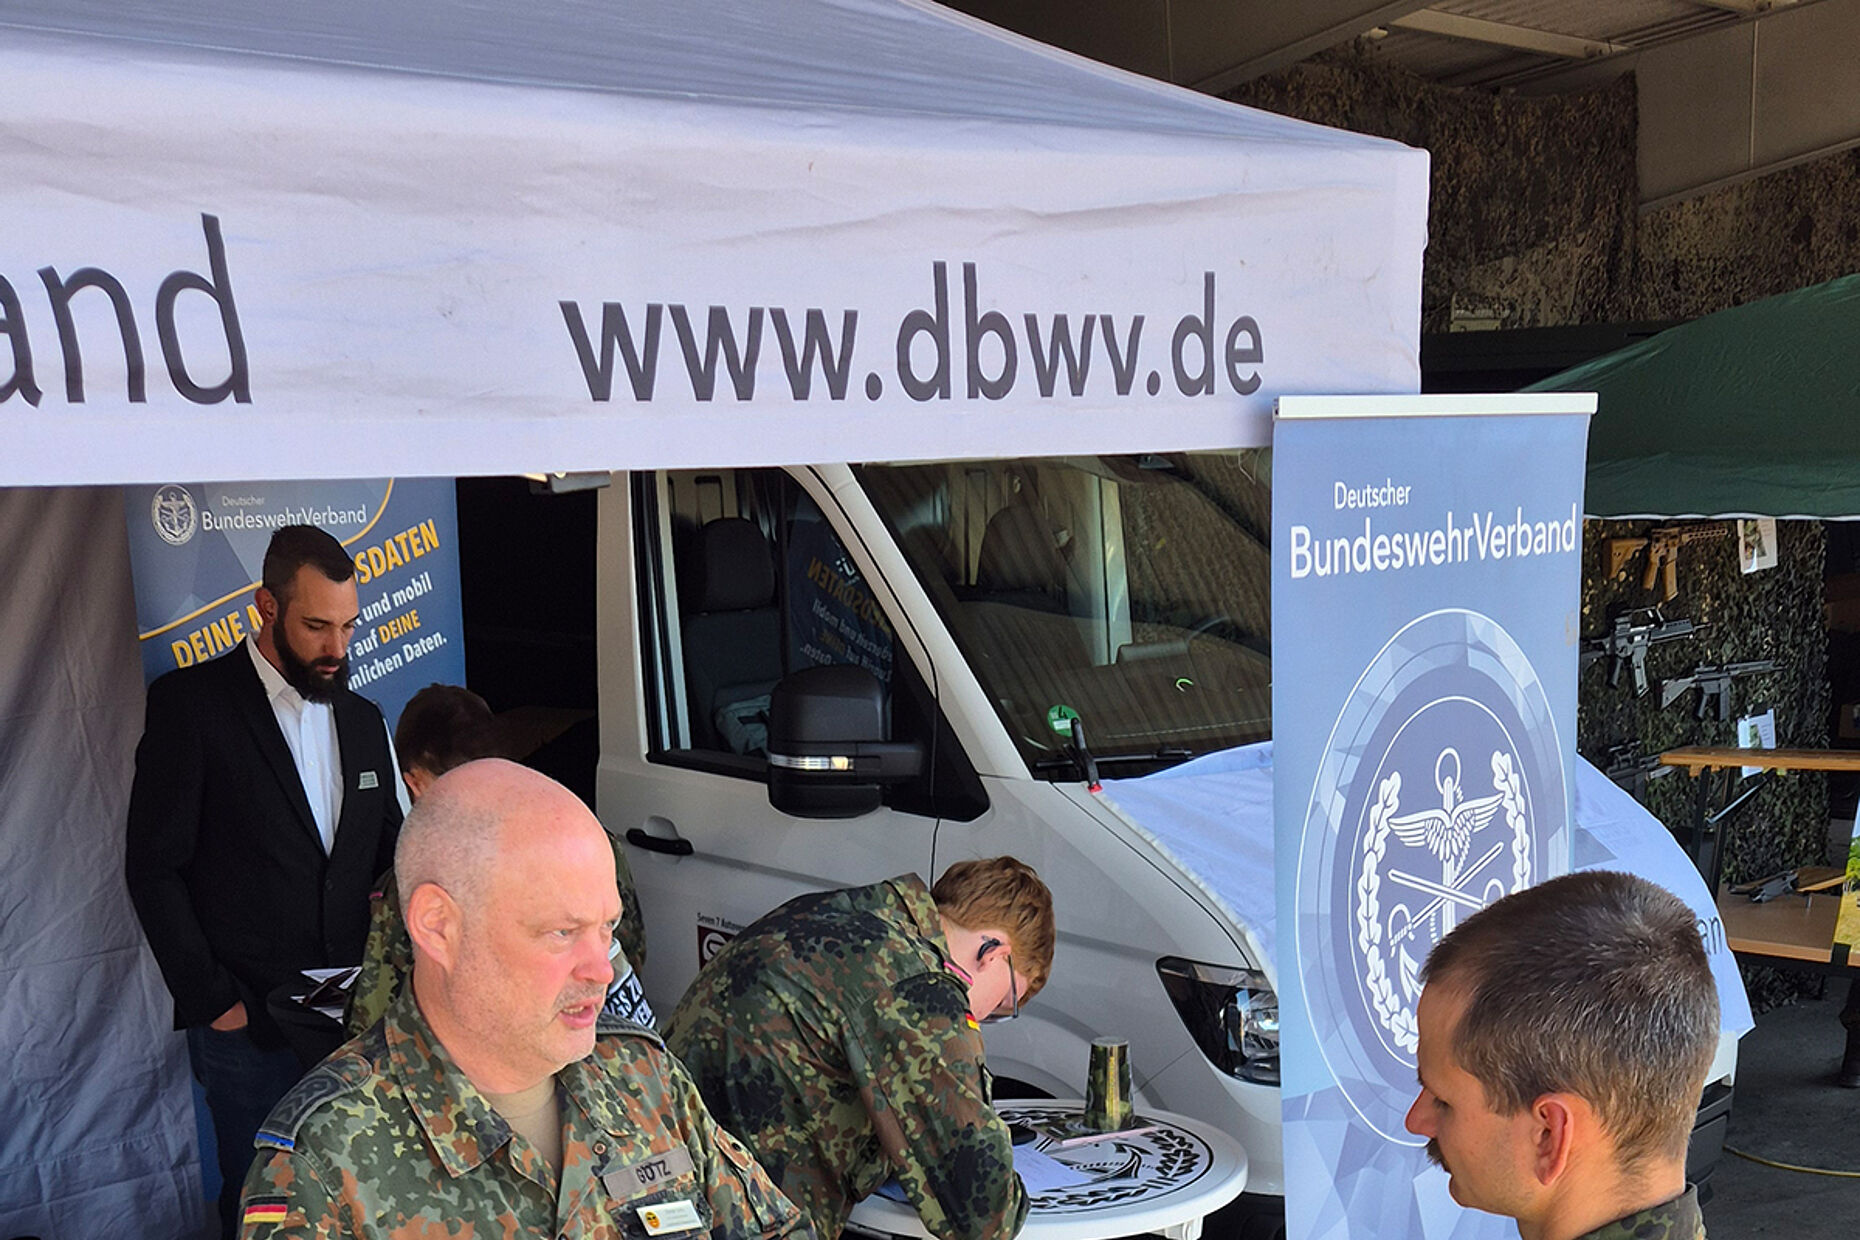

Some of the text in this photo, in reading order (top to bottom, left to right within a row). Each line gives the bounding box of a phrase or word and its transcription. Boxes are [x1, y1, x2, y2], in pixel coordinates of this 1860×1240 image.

[0, 212, 252, 408] and
[558, 260, 1264, 402] www.dbwv.de
[201, 504, 367, 531] BundeswehrVerband
[221, 495, 266, 507] Deutscher
[1334, 477, 1412, 510] Deutscher
[1290, 502, 1577, 579] BundeswehrVerband
[362, 571, 433, 623] und mobil
[171, 611, 246, 669] DEINE
[355, 609, 421, 658] auf DEINE
[402, 631, 447, 663] Daten.
